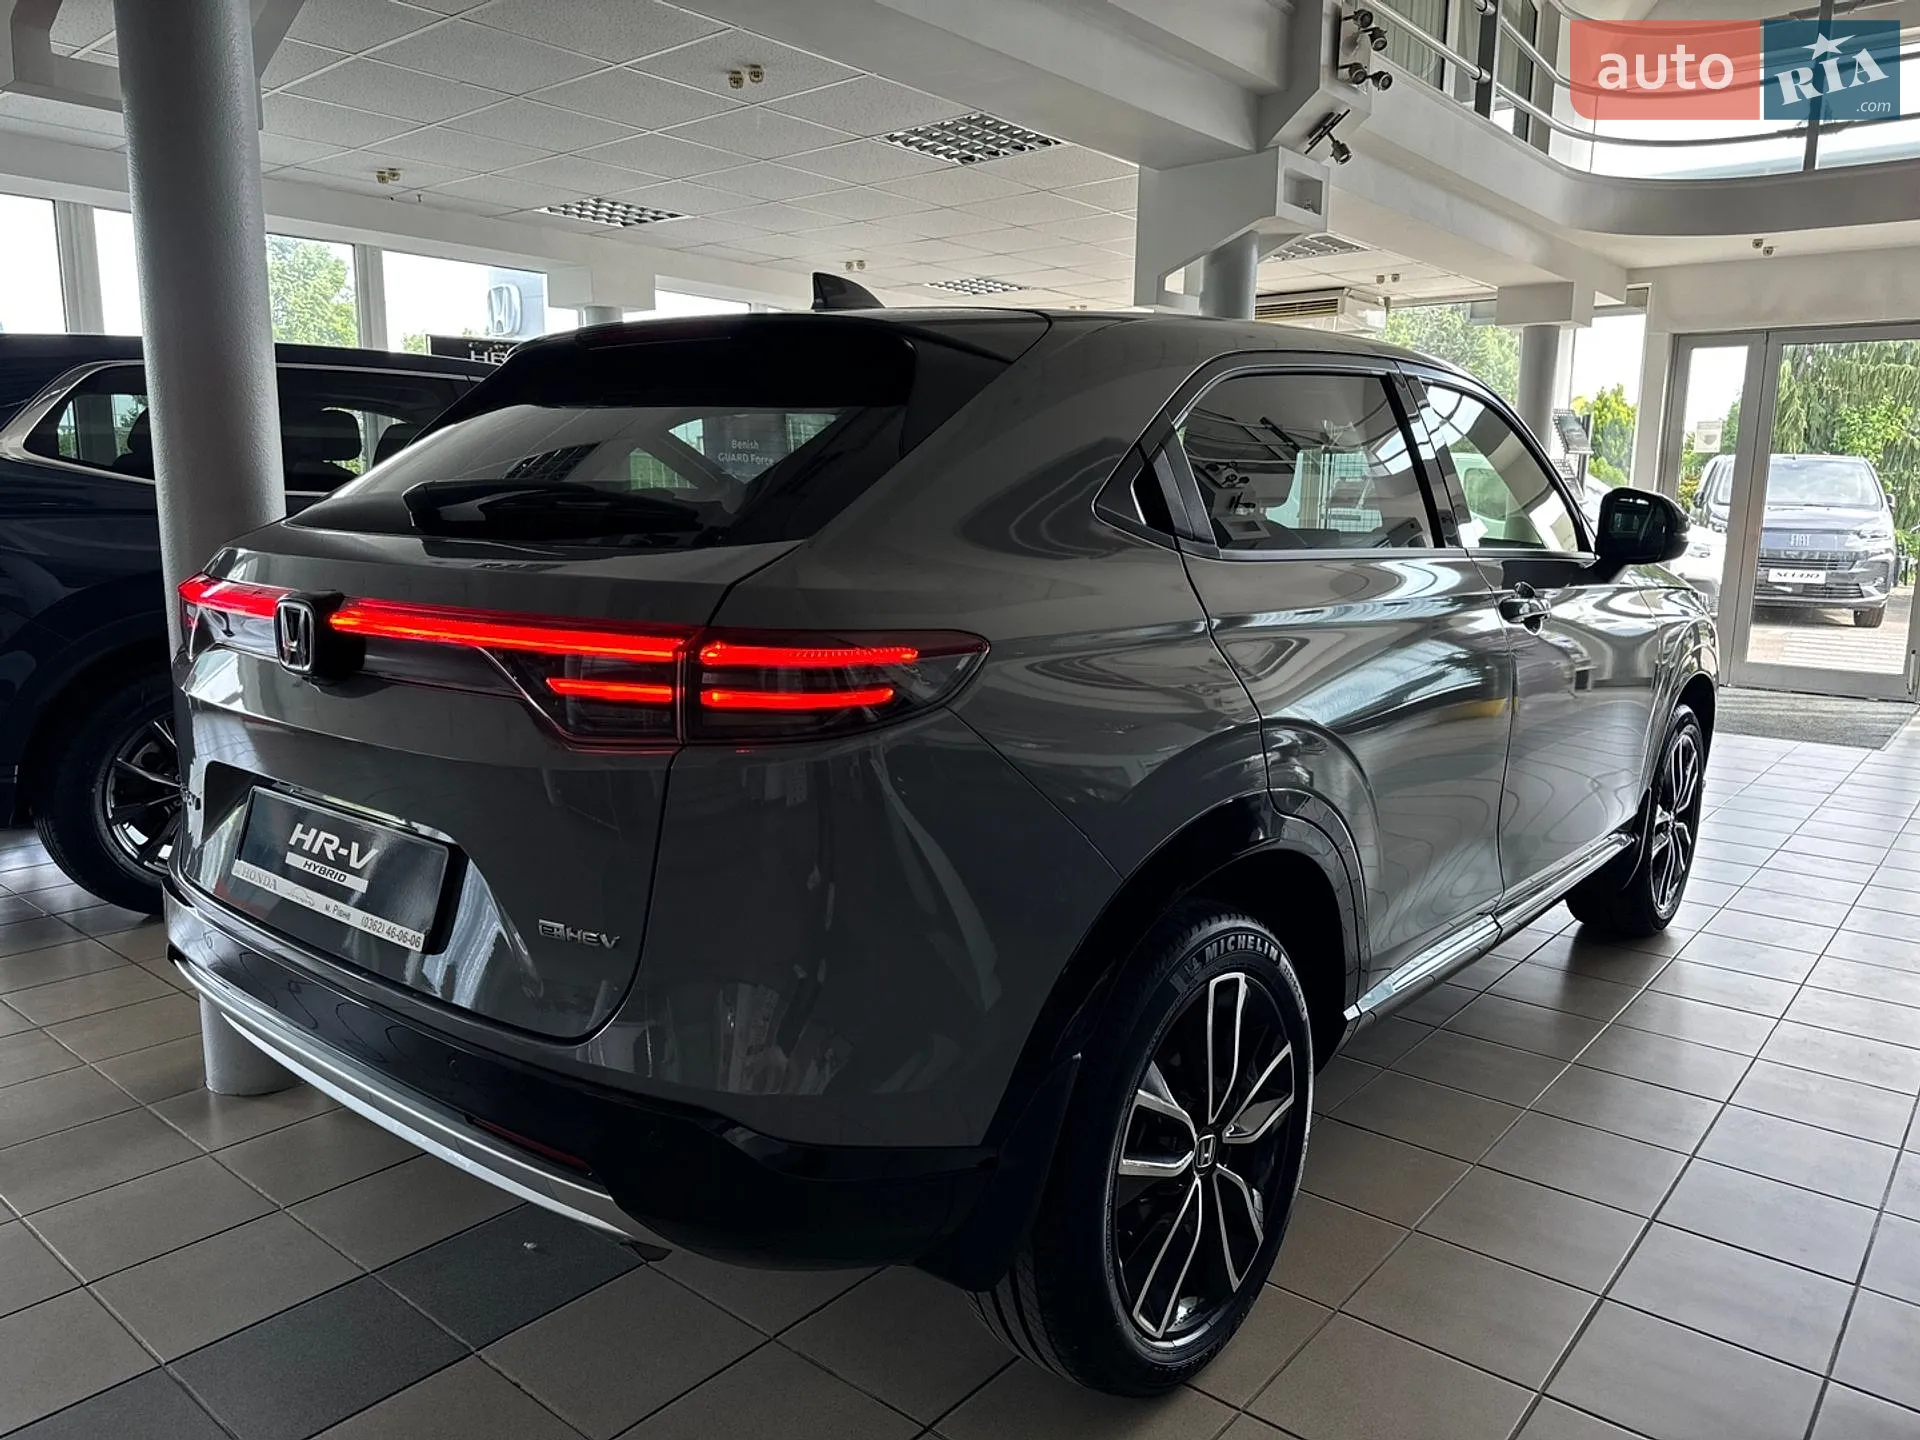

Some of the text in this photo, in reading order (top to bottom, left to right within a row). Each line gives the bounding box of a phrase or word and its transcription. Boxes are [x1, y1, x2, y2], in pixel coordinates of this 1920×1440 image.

[718, 452, 749, 463] GUARD
[1789, 533, 1811, 547] FIAT
[288, 822, 380, 870] HR-V
[241, 866, 278, 891] HONDA
[302, 859, 348, 884] HYBRID
[385, 925, 421, 948] 46-06-06
[1205, 934, 1280, 963] MICHELIN
